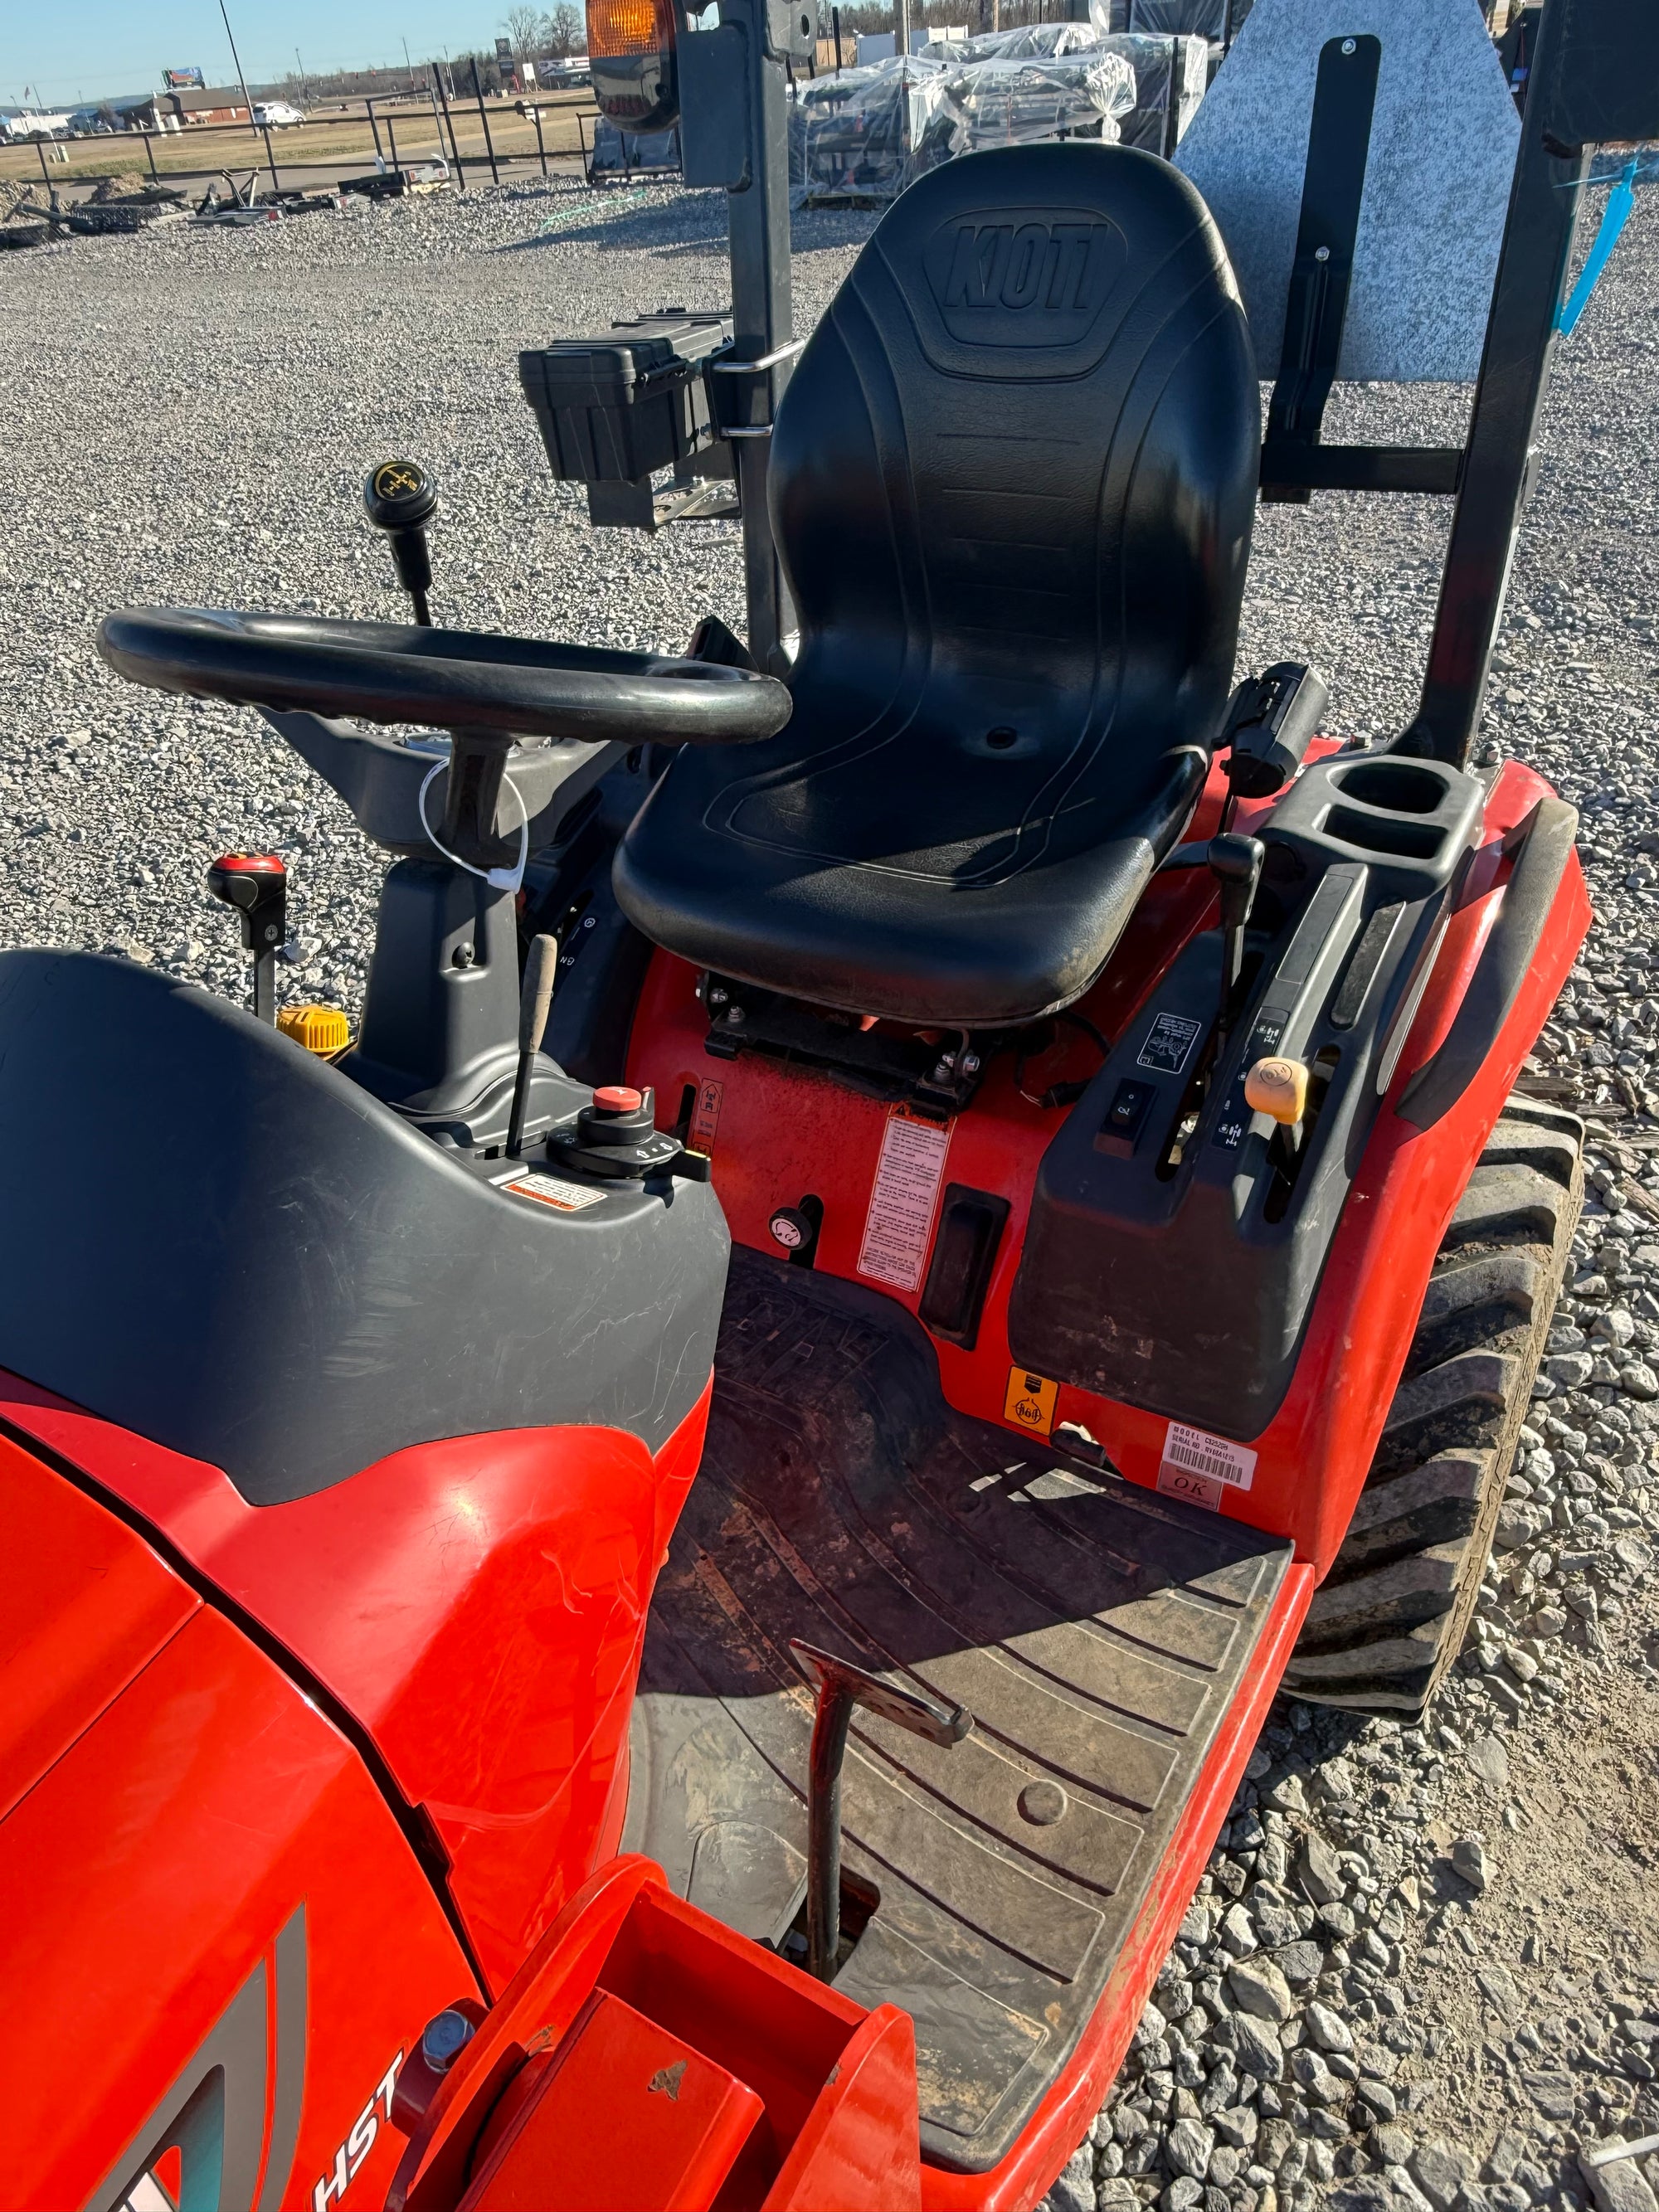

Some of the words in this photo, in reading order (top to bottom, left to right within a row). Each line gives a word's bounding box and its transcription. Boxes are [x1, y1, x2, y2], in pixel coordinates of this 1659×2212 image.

[944, 222, 1108, 309] KIOTI
[1171, 1434, 1190, 1446] SERIAL
[1173, 1426, 1199, 1441] MODEL
[1174, 1476, 1208, 1496] OK
[312, 2048, 405, 2212] HST
